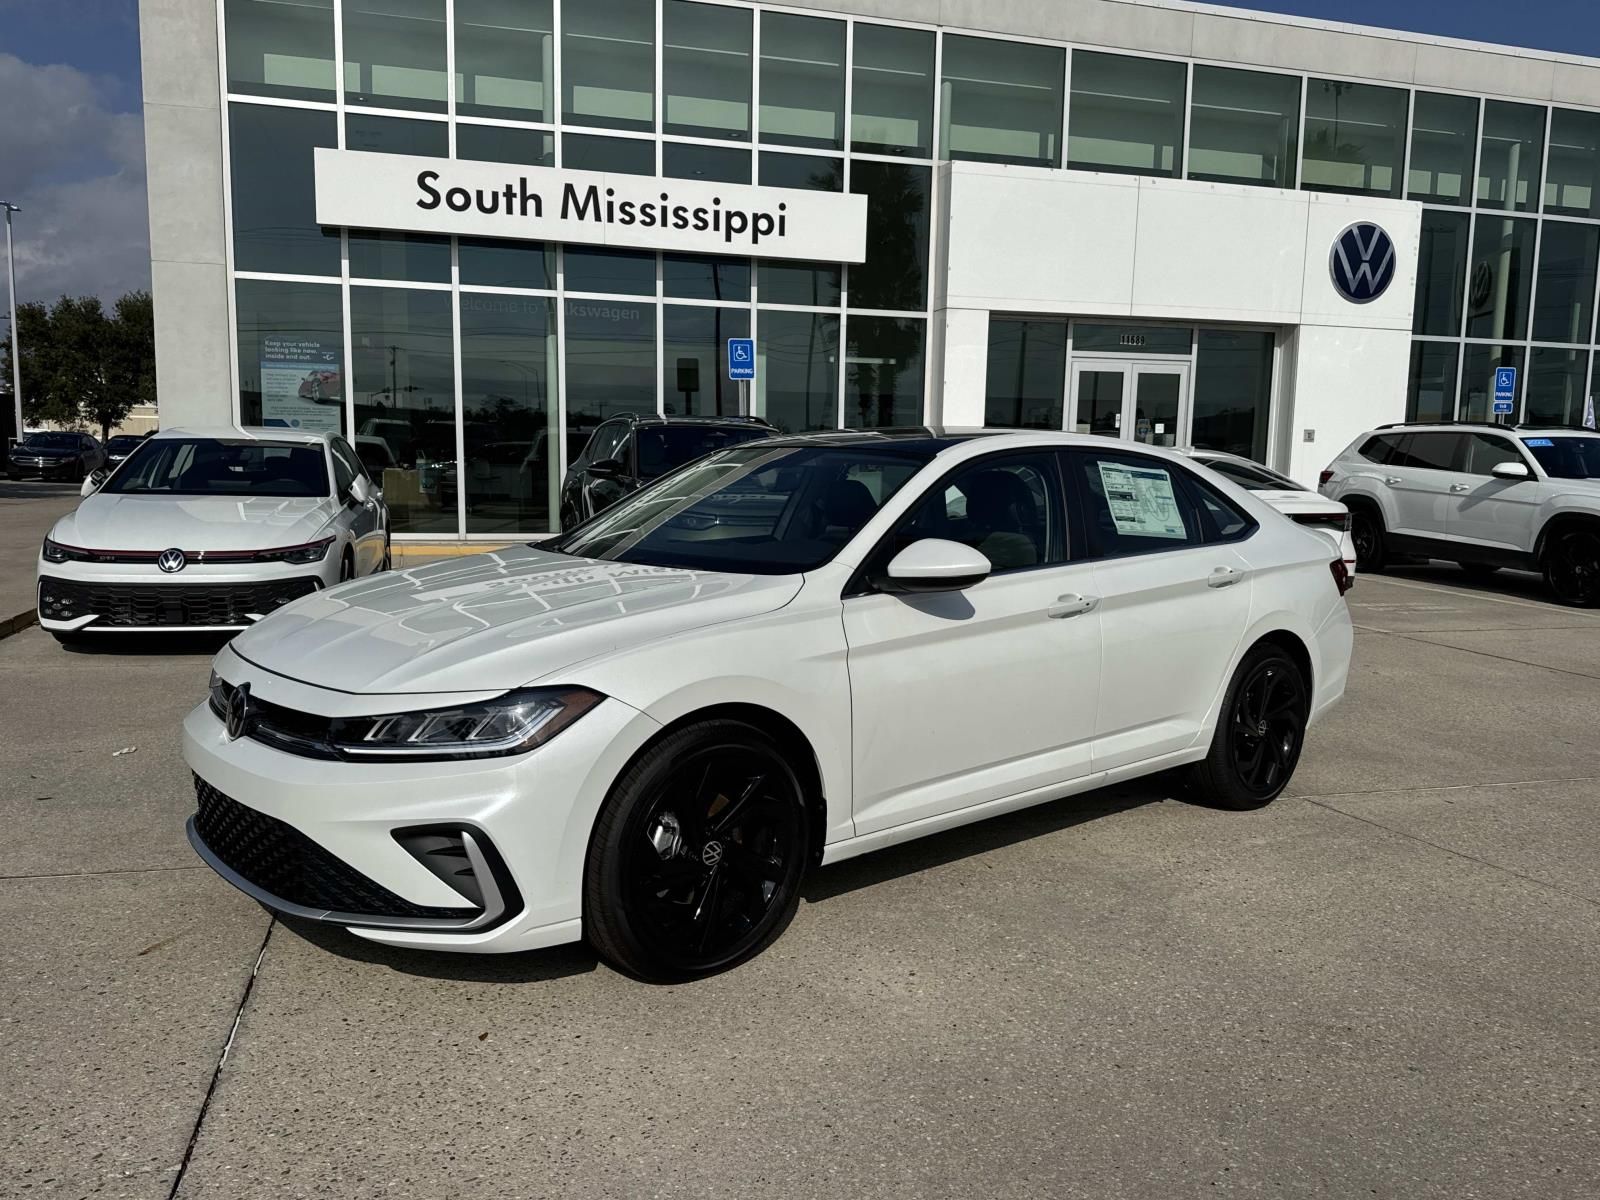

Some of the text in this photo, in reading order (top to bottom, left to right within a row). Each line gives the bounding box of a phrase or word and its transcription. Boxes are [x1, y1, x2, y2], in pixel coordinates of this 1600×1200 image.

[416, 170, 787, 244] South Mississippi
[1332, 223, 1394, 299] VW
[264, 346, 289, 354] looking
[160, 550, 184, 570] VW
